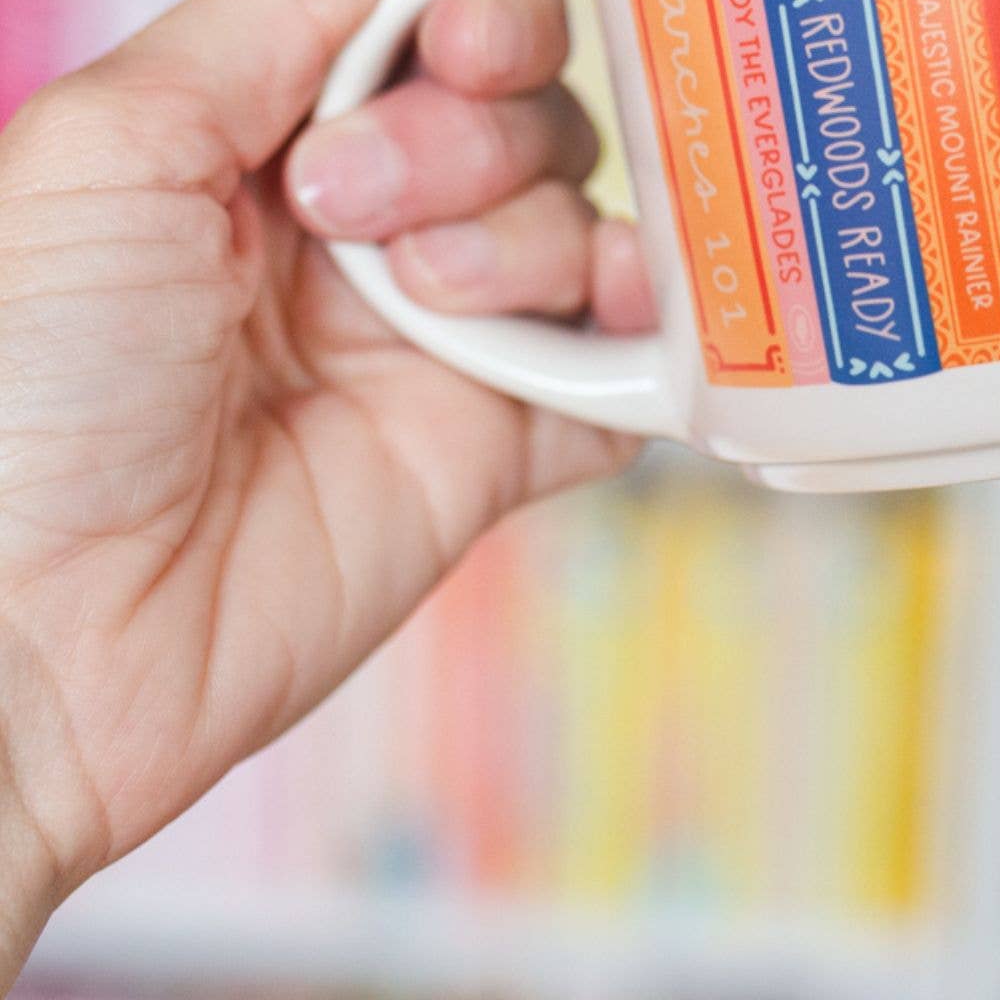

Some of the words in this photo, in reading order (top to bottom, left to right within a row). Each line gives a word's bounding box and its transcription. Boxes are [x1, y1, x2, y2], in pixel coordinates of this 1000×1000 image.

[738, 34, 768, 87] THE
[800, 12, 877, 212] REDWOODS
[747, 95, 803, 285] EVERGLADES
[938, 104, 976, 208] MOUNT
[704, 231, 748, 329] 101
[837, 226, 902, 343] READY
[954, 210, 995, 311] RAINIER
